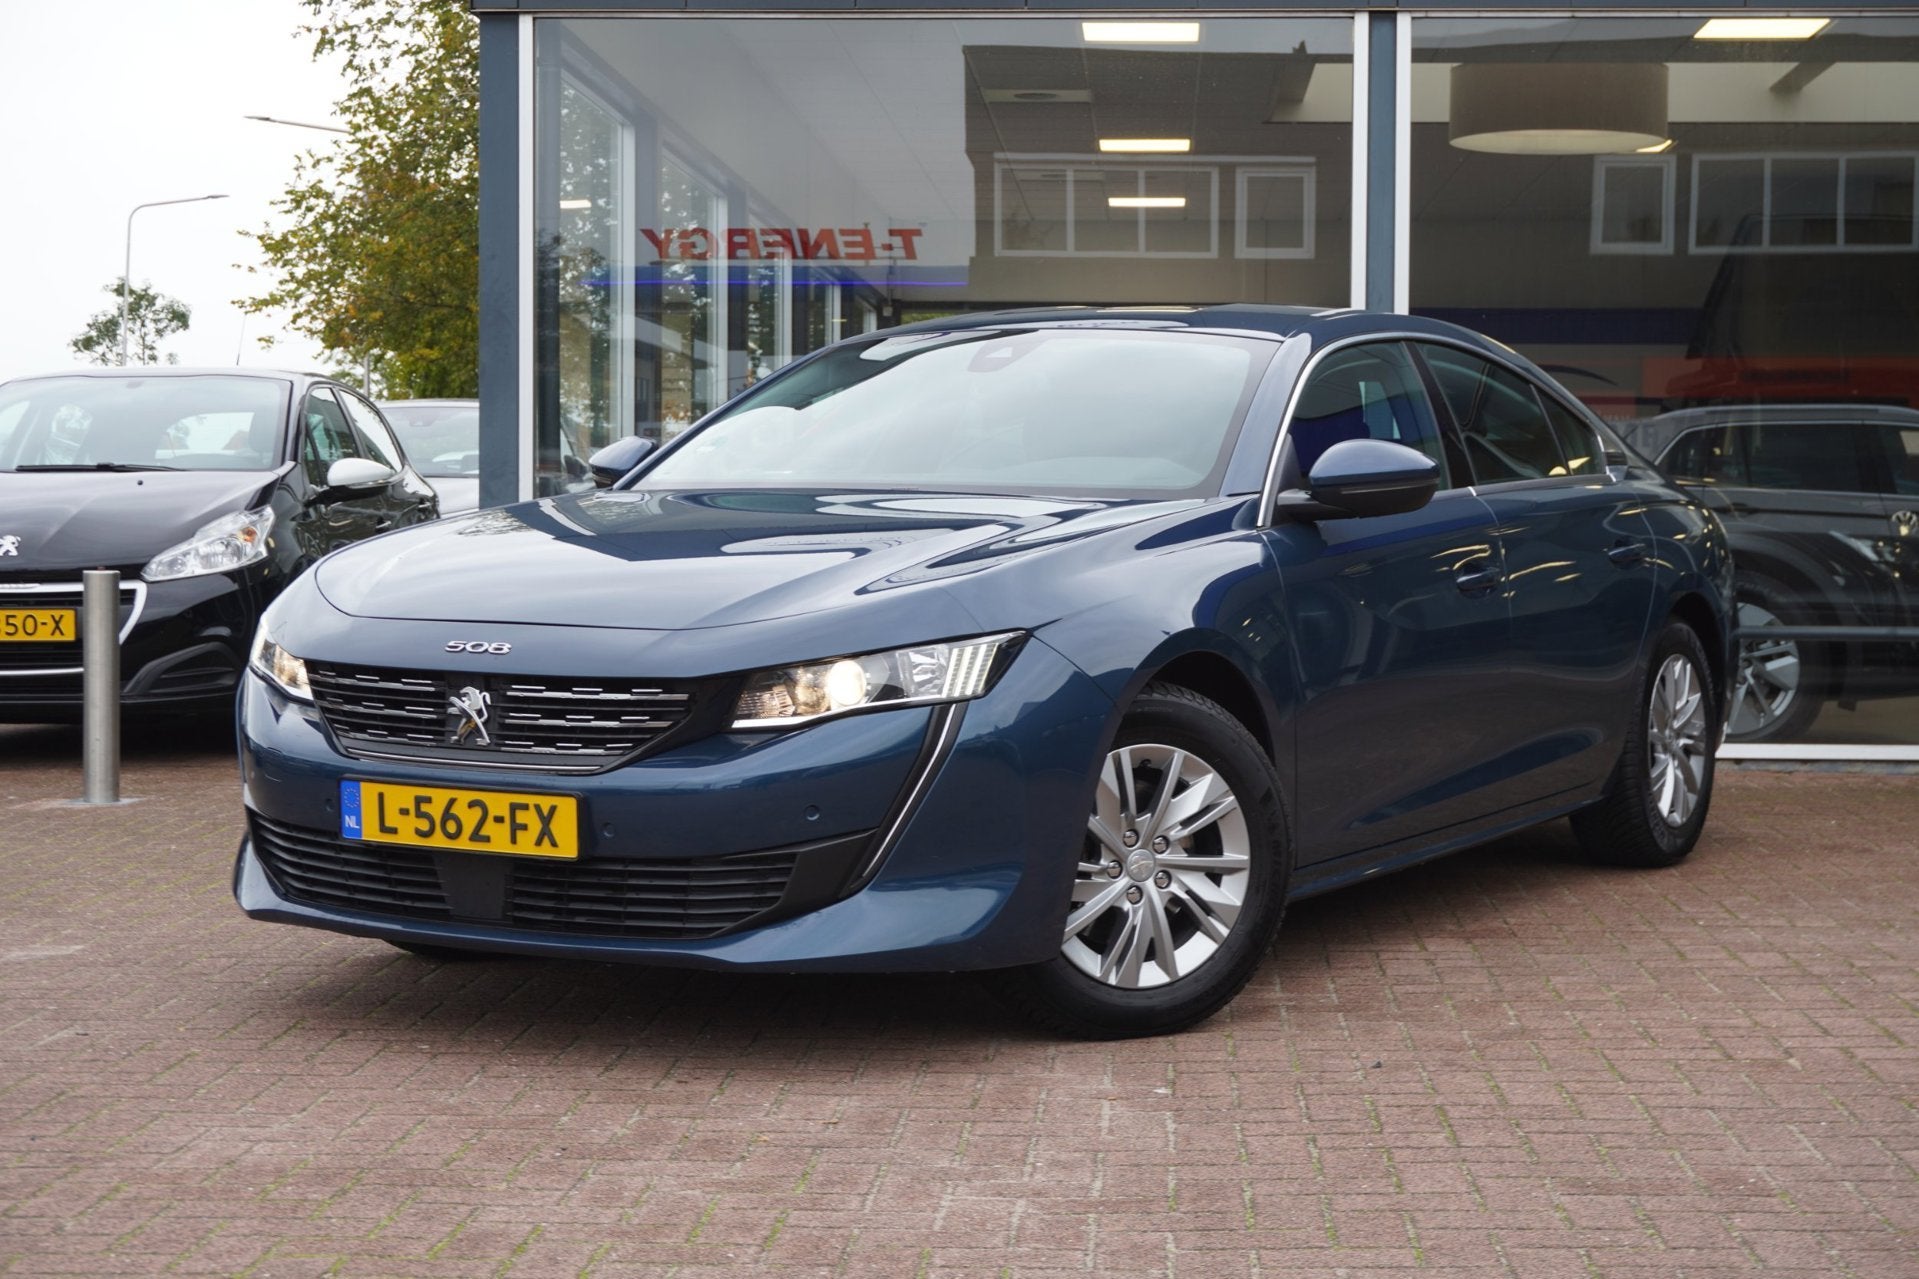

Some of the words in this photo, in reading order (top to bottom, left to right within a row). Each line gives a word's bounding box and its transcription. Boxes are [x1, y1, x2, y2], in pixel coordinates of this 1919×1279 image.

[0, 614, 65, 637] 50-X
[444, 640, 512, 655] 508
[344, 814, 360, 830] NL
[377, 791, 559, 848] L-562-FX
